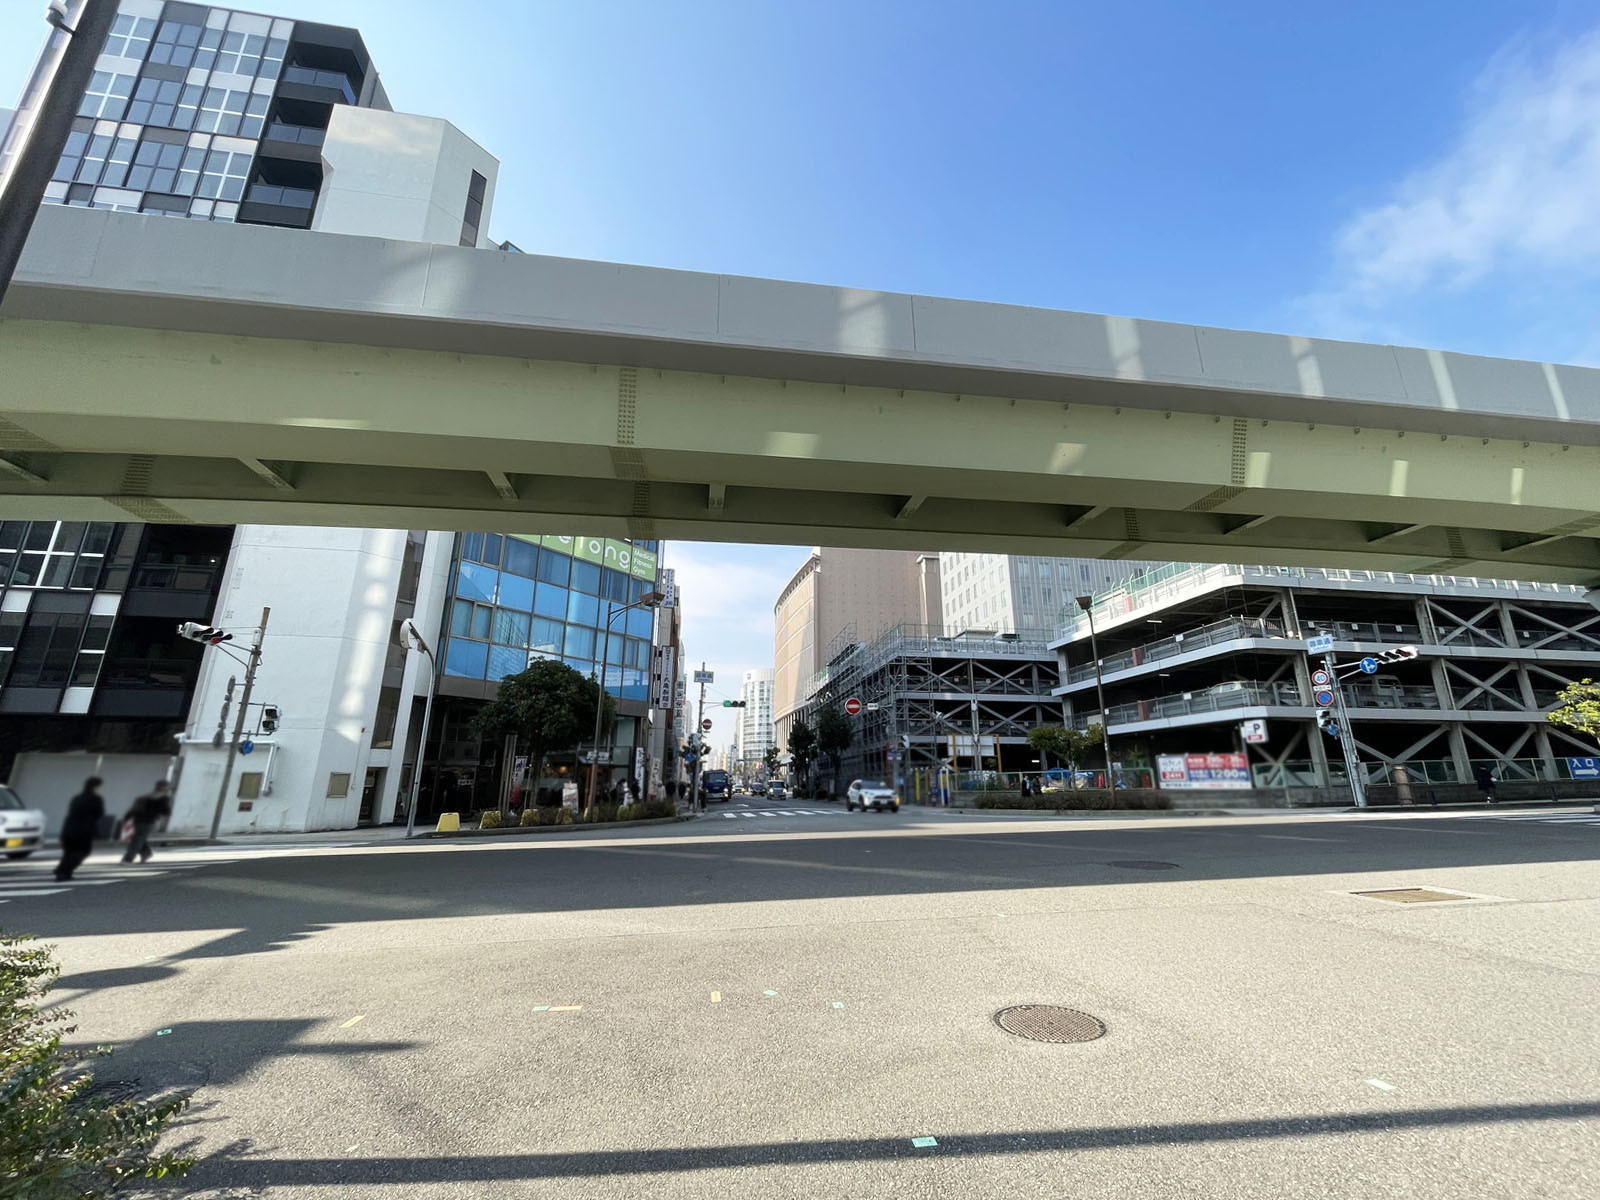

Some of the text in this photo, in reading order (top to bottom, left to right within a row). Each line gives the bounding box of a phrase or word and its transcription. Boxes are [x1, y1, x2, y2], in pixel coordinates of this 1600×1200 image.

[545, 535, 630, 569] elong
[633, 547, 655, 562] Medical
[632, 566, 646, 576] Gym
[1253, 723, 1261, 734] P
[1572, 758, 1594, 768] 入口
